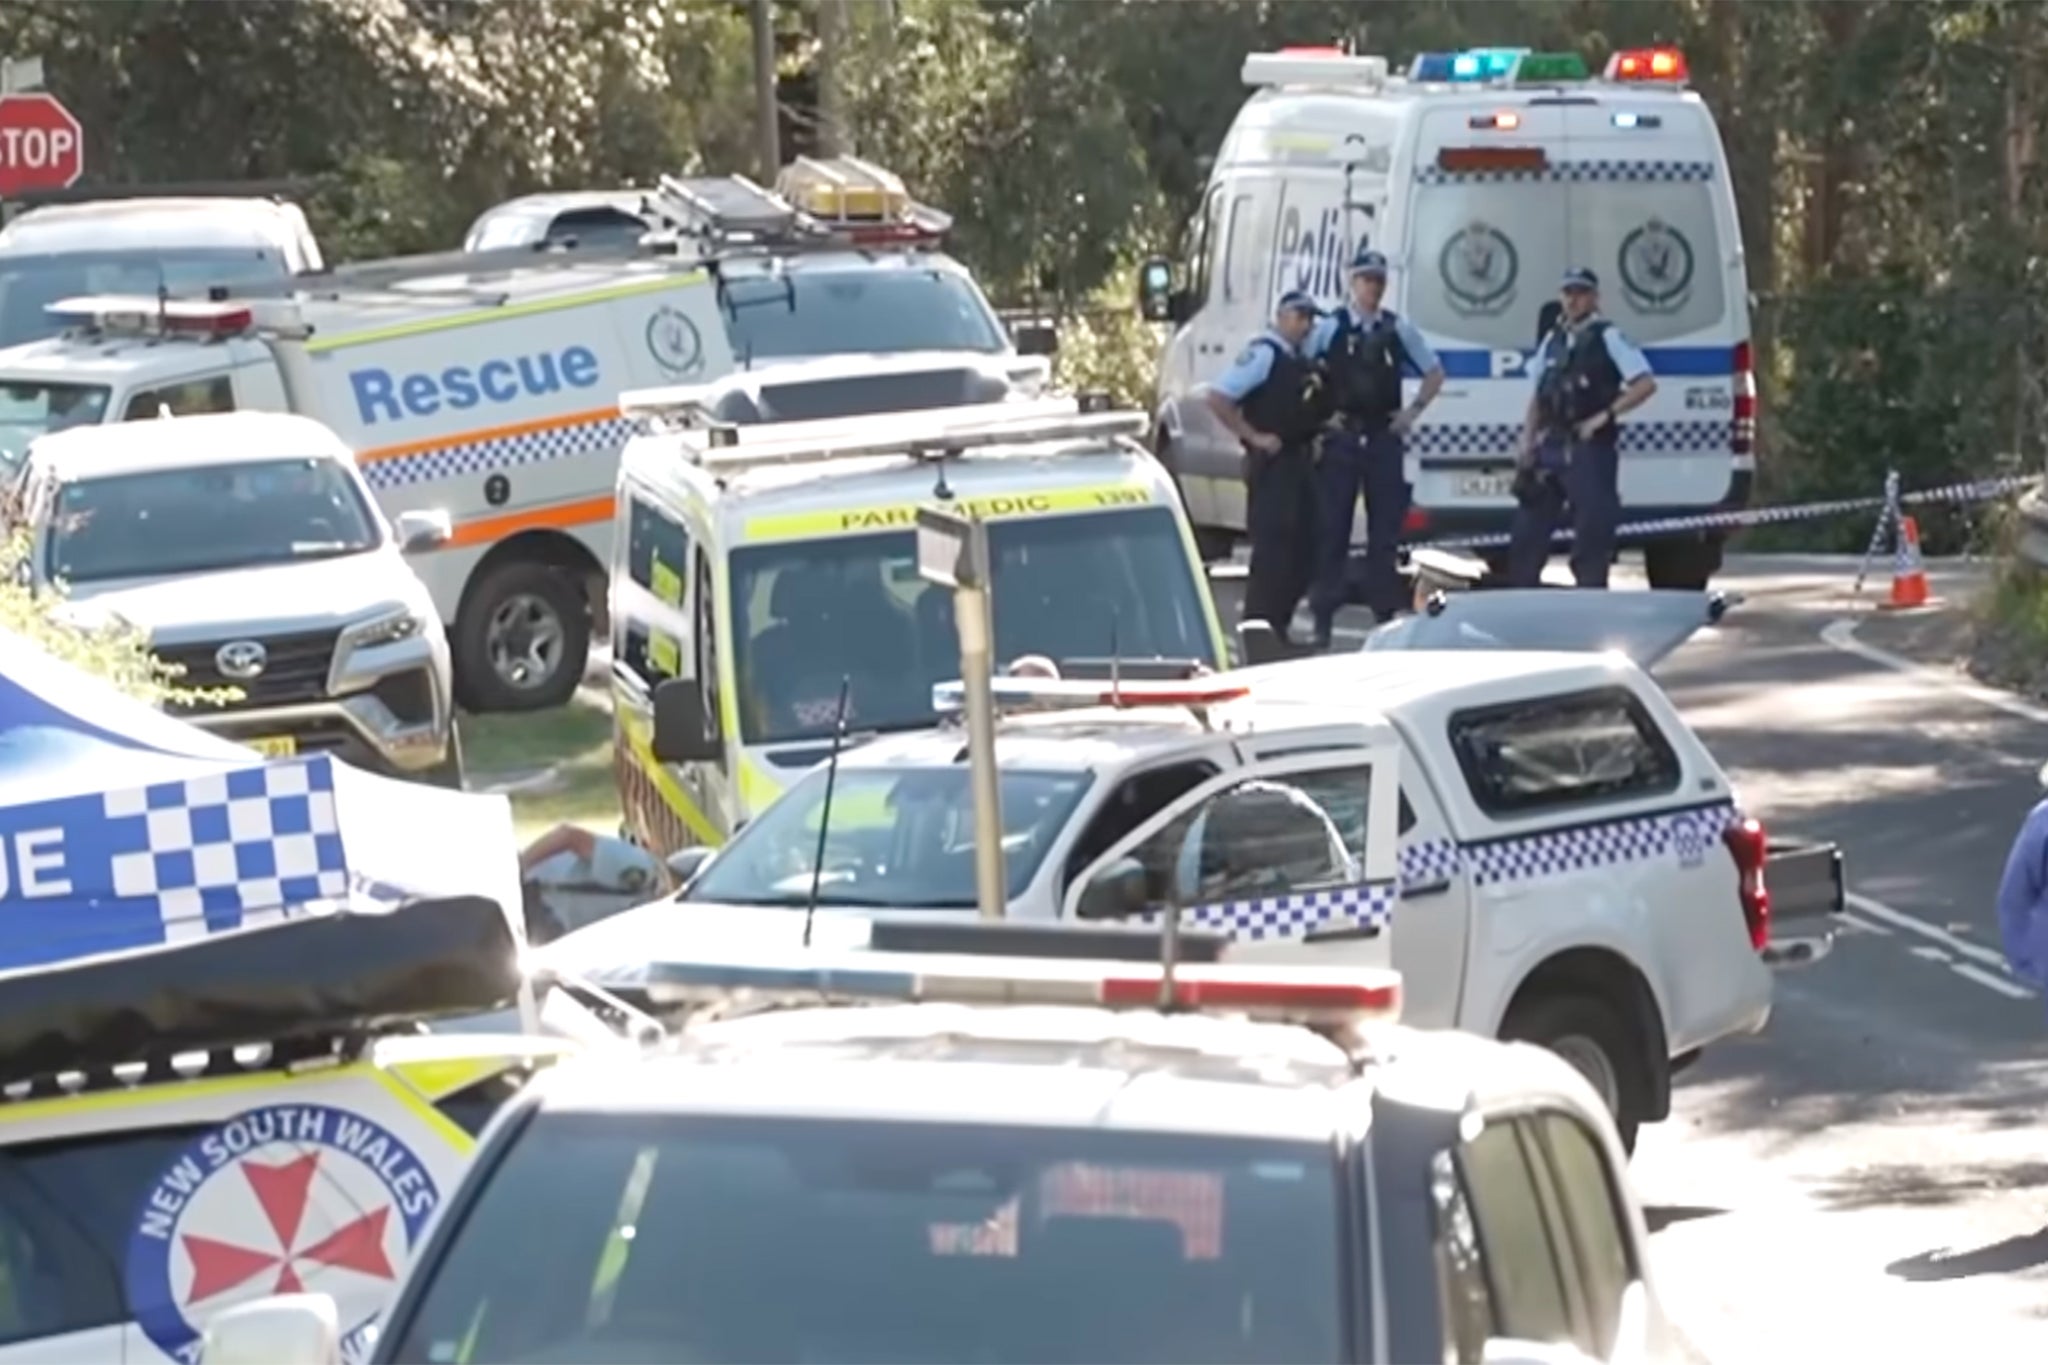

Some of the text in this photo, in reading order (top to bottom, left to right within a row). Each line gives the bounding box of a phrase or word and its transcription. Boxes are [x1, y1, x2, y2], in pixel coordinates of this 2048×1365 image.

[0, 127, 74, 168] TOP
[1277, 205, 1369, 298] Polic
[349, 345, 600, 425] Rescue
[841, 495, 1051, 529] PARMEDIC
[0, 827, 73, 899] E
[140, 1109, 433, 1239] NEW SOUTH WALES
